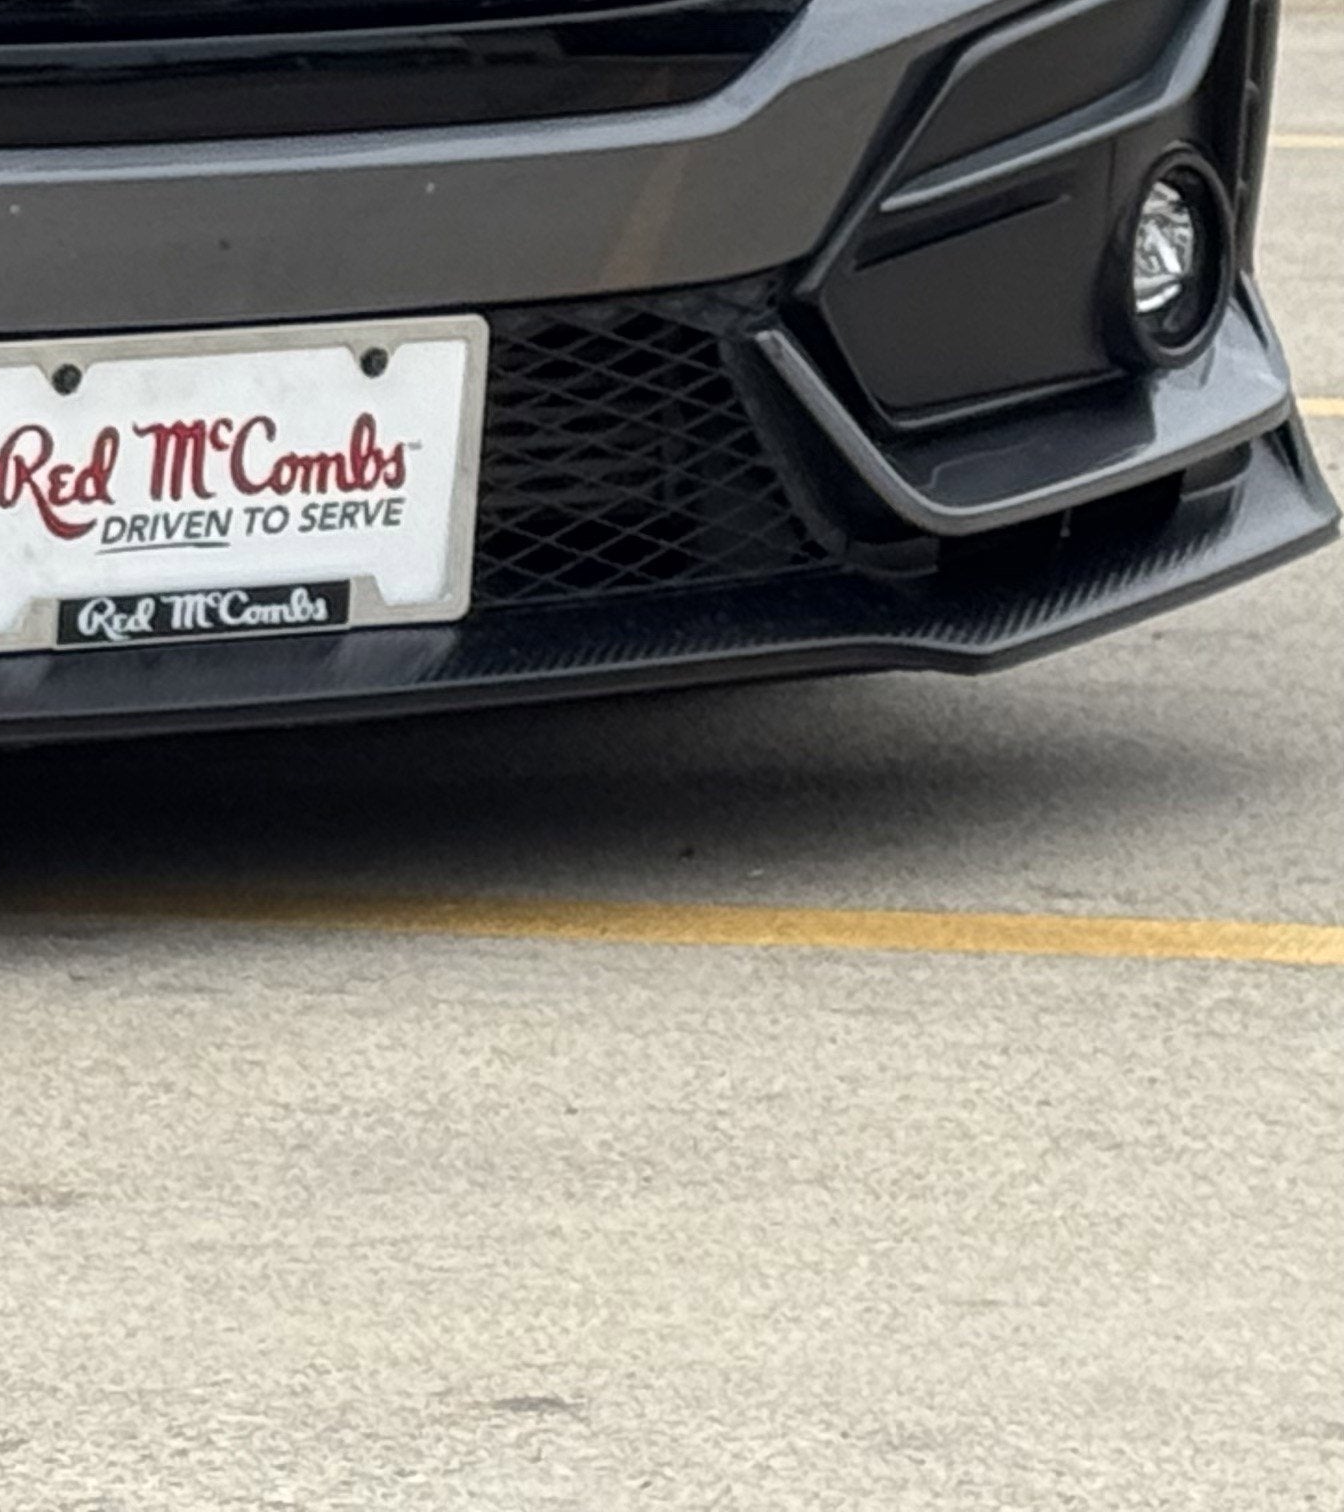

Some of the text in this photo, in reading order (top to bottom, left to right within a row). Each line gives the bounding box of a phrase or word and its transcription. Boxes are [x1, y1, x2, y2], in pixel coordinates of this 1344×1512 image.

[133, 413, 406, 501] McCombs
[101, 497, 405, 544] DRIVEN TO SERVE
[77, 588, 328, 641] Red McCombs
